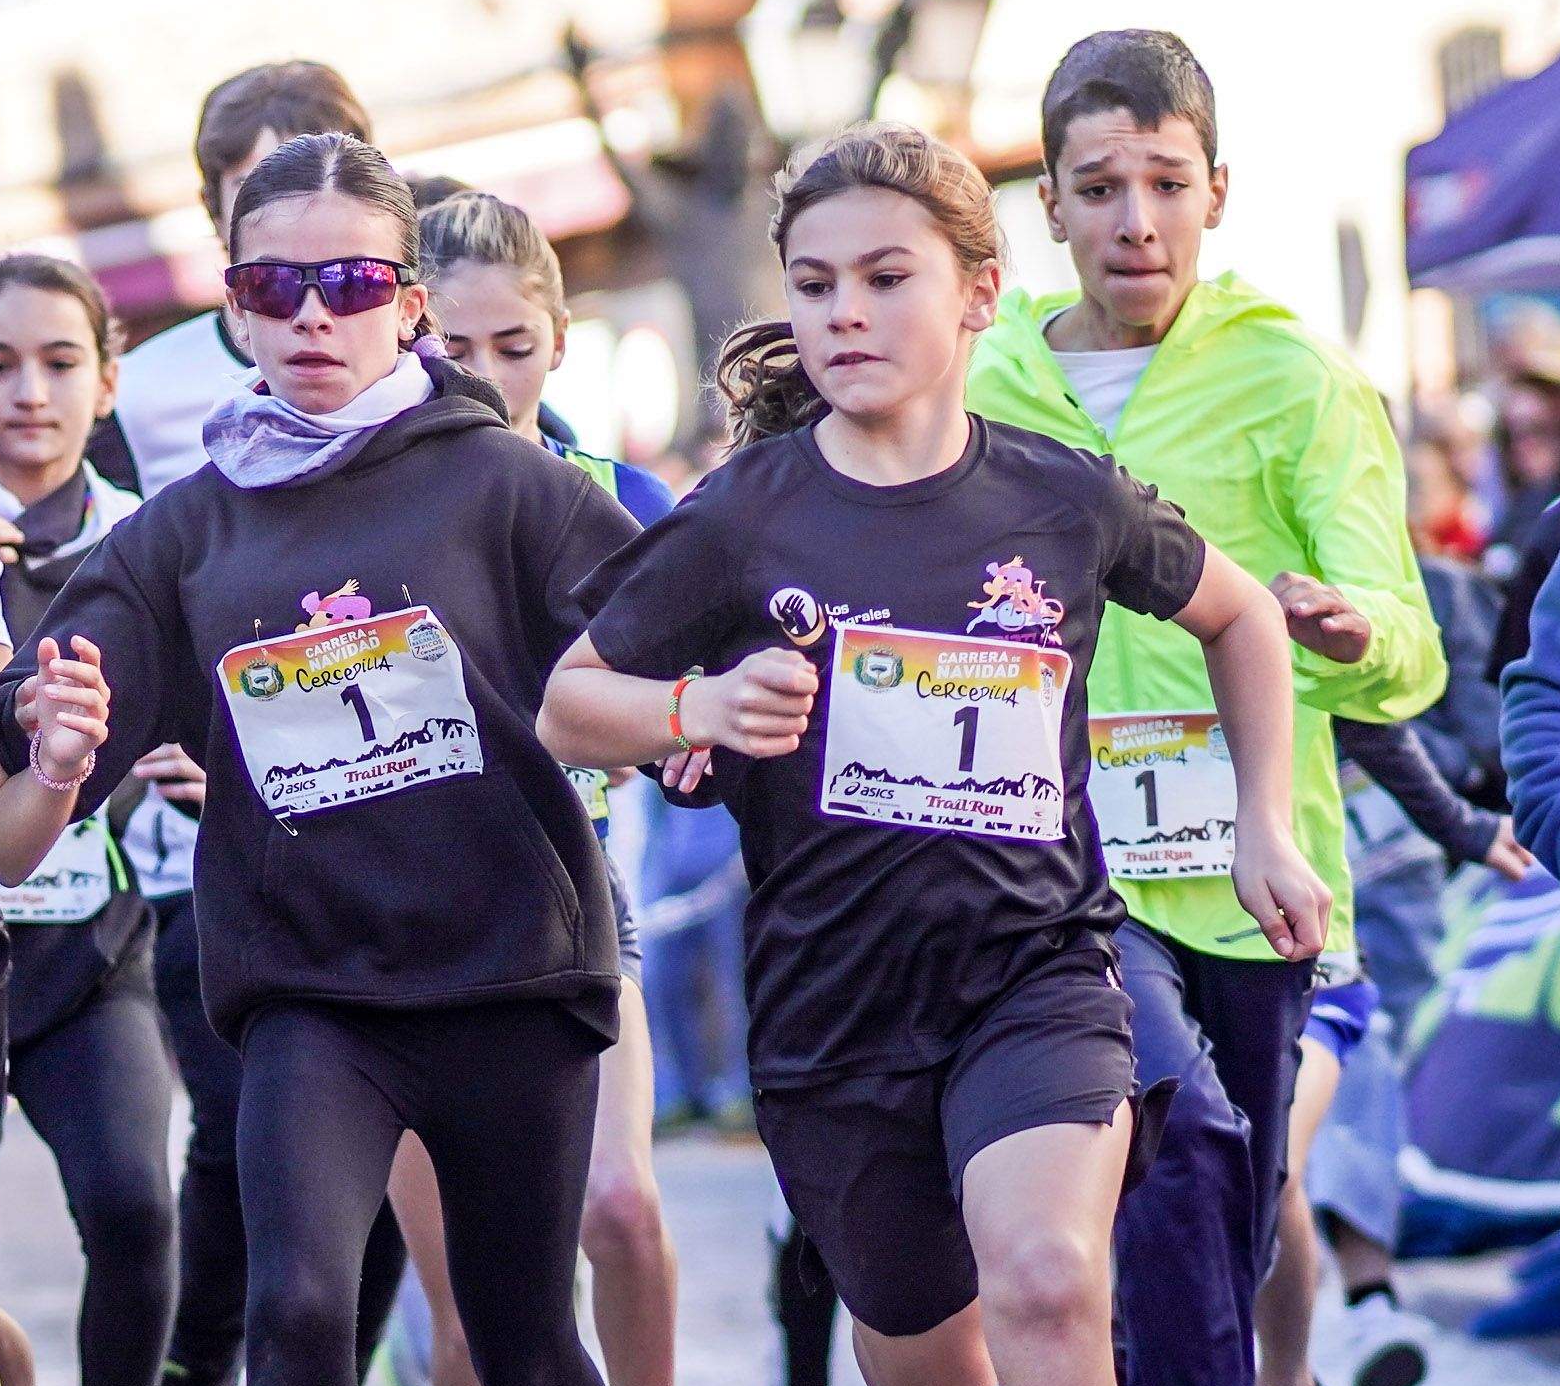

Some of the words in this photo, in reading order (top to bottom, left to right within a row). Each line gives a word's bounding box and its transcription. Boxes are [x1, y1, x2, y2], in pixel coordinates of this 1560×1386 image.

[824, 603, 850, 616] Los
[304, 628, 367, 659] CARRERA
[308, 637, 381, 672] NAVIDAD
[937, 651, 1009, 664] CARRERA
[936, 664, 1020, 679] NAVIDAD
[340, 683, 377, 743] 1
[953, 705, 980, 773] 1
[1111, 728, 1185, 752] NAVIDAD
[344, 765, 383, 784] Trail
[383, 756, 418, 774] Run
[285, 778, 316, 795] asics
[860, 786, 895, 800] asics
[1134, 769, 1159, 827] 1
[925, 794, 971, 812] Trail
[971, 797, 1004, 816] Run
[1123, 851, 1161, 863] Trail
[1161, 849, 1194, 862] Run
